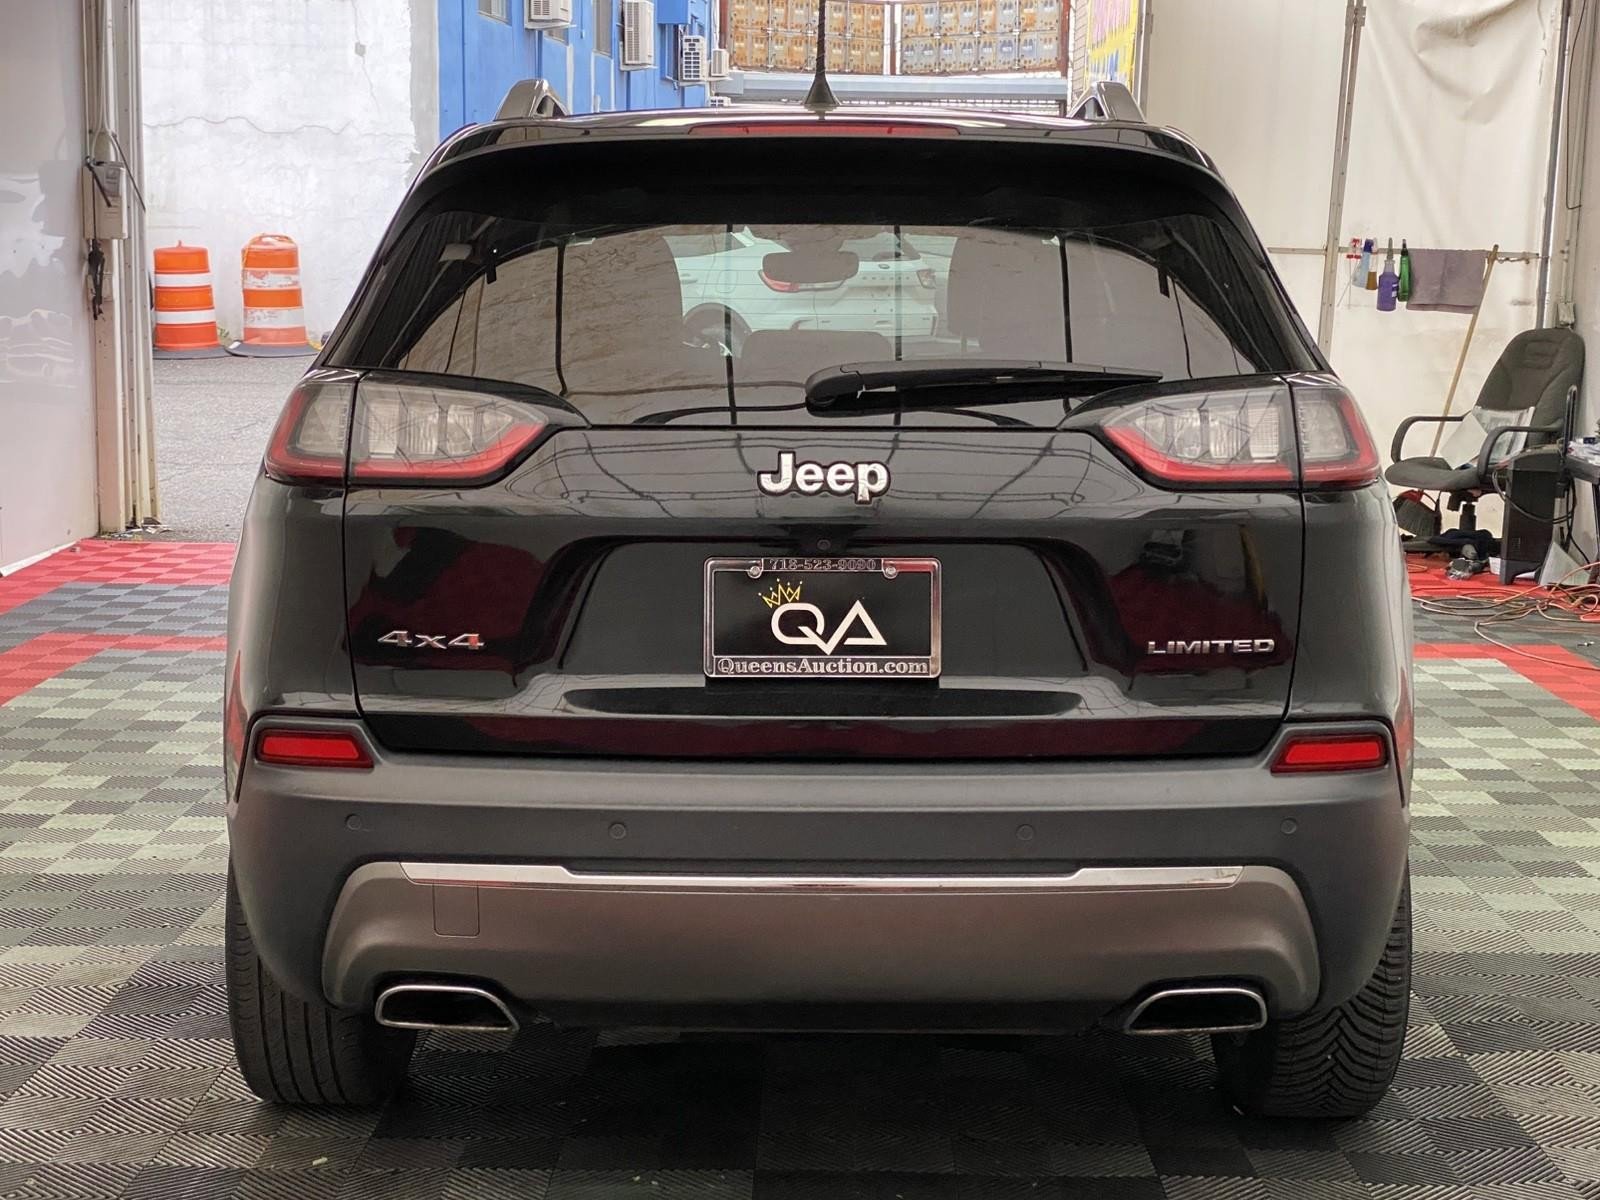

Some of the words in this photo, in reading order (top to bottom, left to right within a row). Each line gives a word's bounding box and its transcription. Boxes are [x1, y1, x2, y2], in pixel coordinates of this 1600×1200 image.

[758, 451, 890, 503] Jeep
[769, 558, 877, 570] 718-523-9090
[378, 630, 484, 650] 4x4
[1148, 639, 1275, 654] LIMITED
[717, 658, 929, 675] QueensAuction.com
